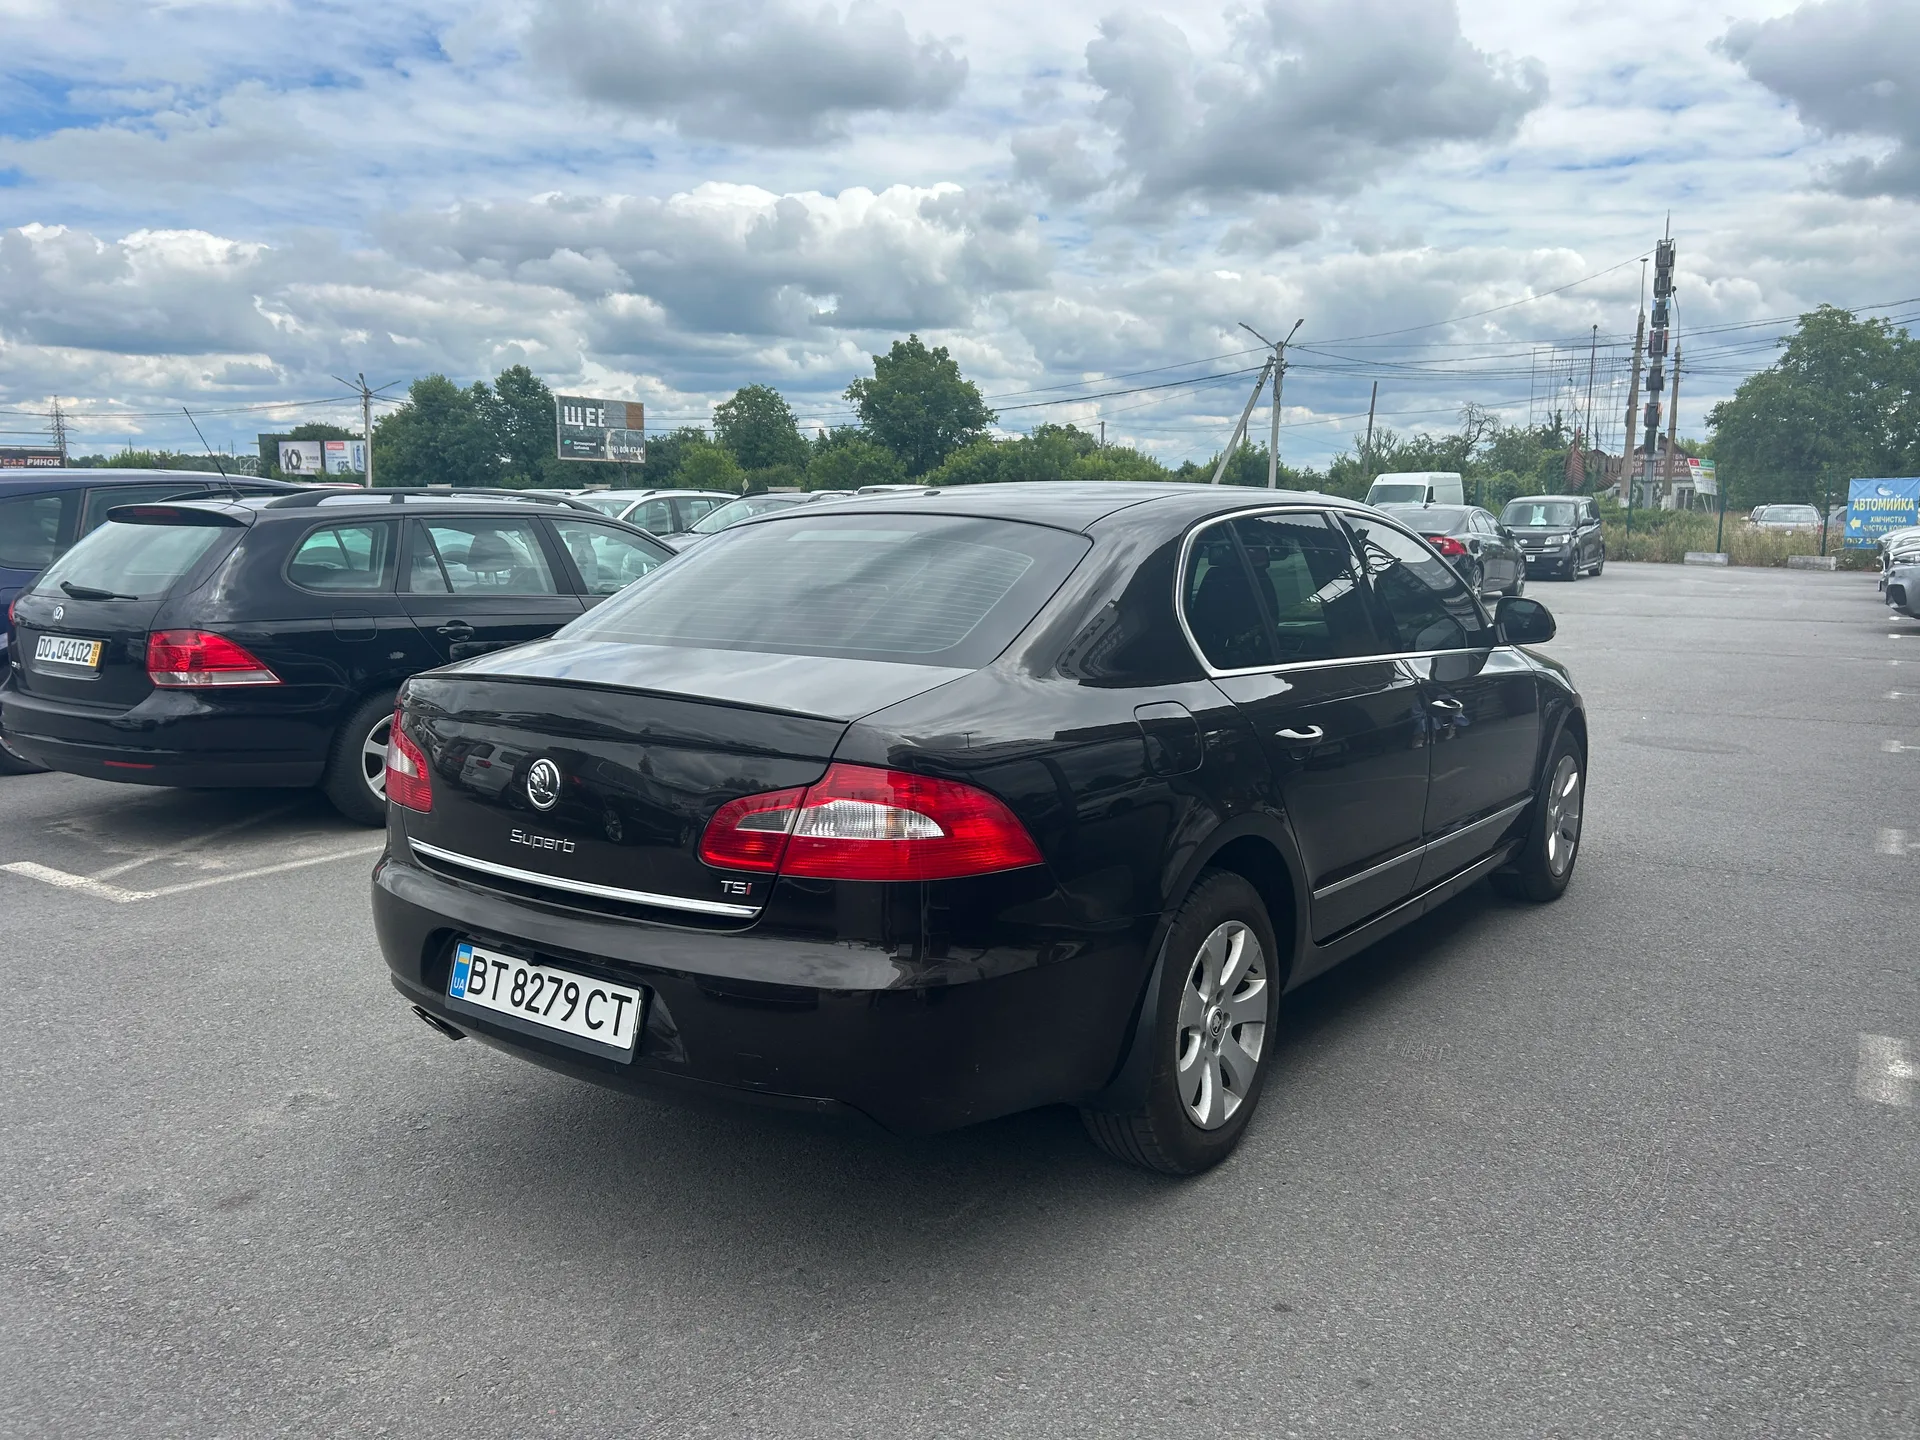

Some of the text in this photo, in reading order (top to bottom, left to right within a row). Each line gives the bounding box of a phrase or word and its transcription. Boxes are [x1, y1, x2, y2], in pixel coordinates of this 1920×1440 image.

[26, 458, 60, 466] РИНОК
[1853, 494, 1915, 511] АВТОМИЙКА
[37, 638, 92, 663] DO 04102
[510, 828, 575, 854] Superb
[454, 976, 465, 991] UA
[467, 955, 633, 1037] BT 8279 CT
